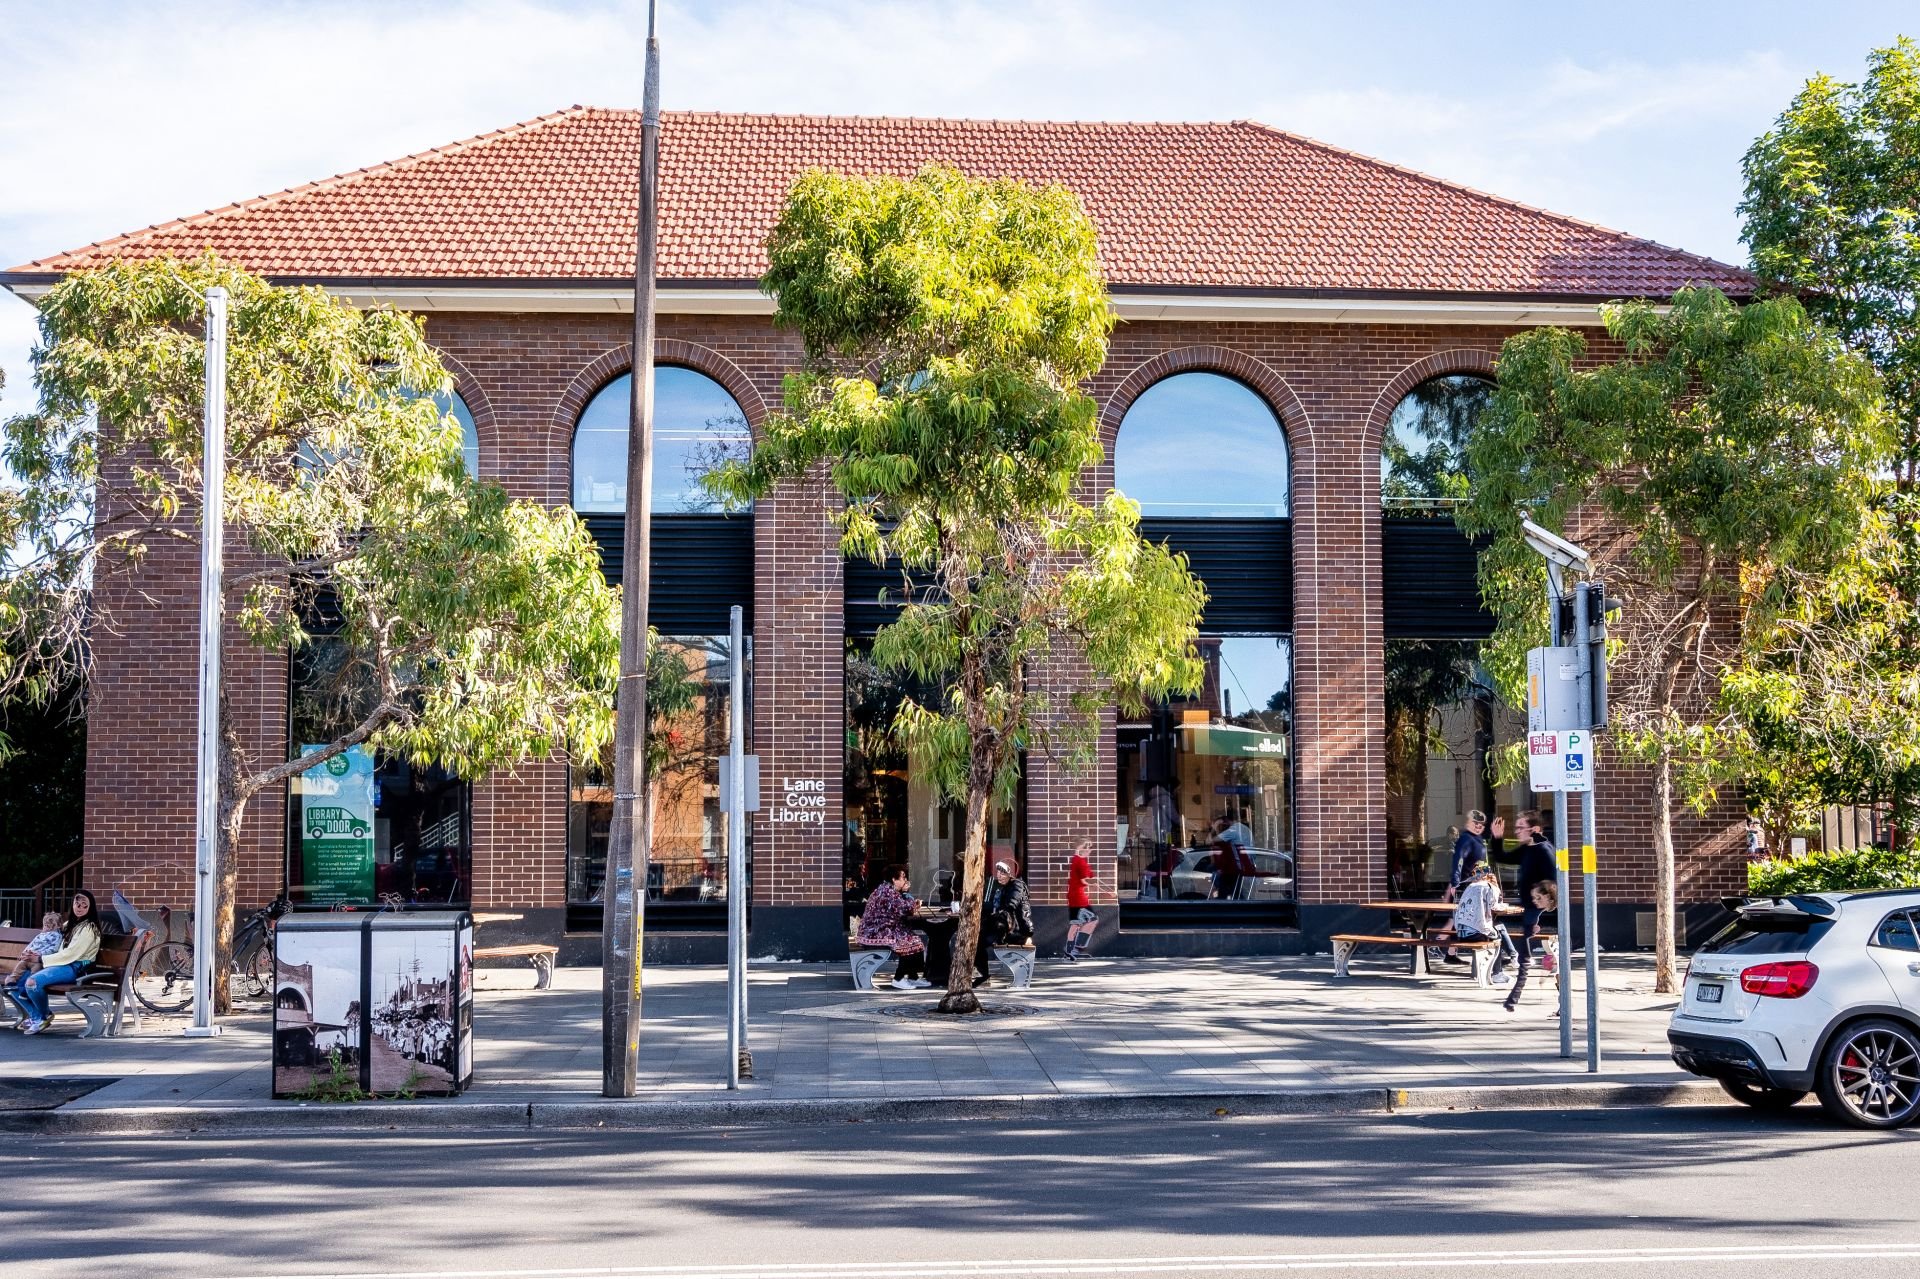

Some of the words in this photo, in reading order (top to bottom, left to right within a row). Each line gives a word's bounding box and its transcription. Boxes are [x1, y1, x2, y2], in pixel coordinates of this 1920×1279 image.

[1534, 736, 1552, 744] BUS
[1569, 736, 1580, 749] P
[1534, 746, 1554, 754] ZONE
[784, 777, 826, 791] Lane
[786, 792, 826, 807] Cove
[308, 808, 340, 820] LIBRARY
[770, 808, 826, 825] Library
[327, 820, 350, 832] DOOR
